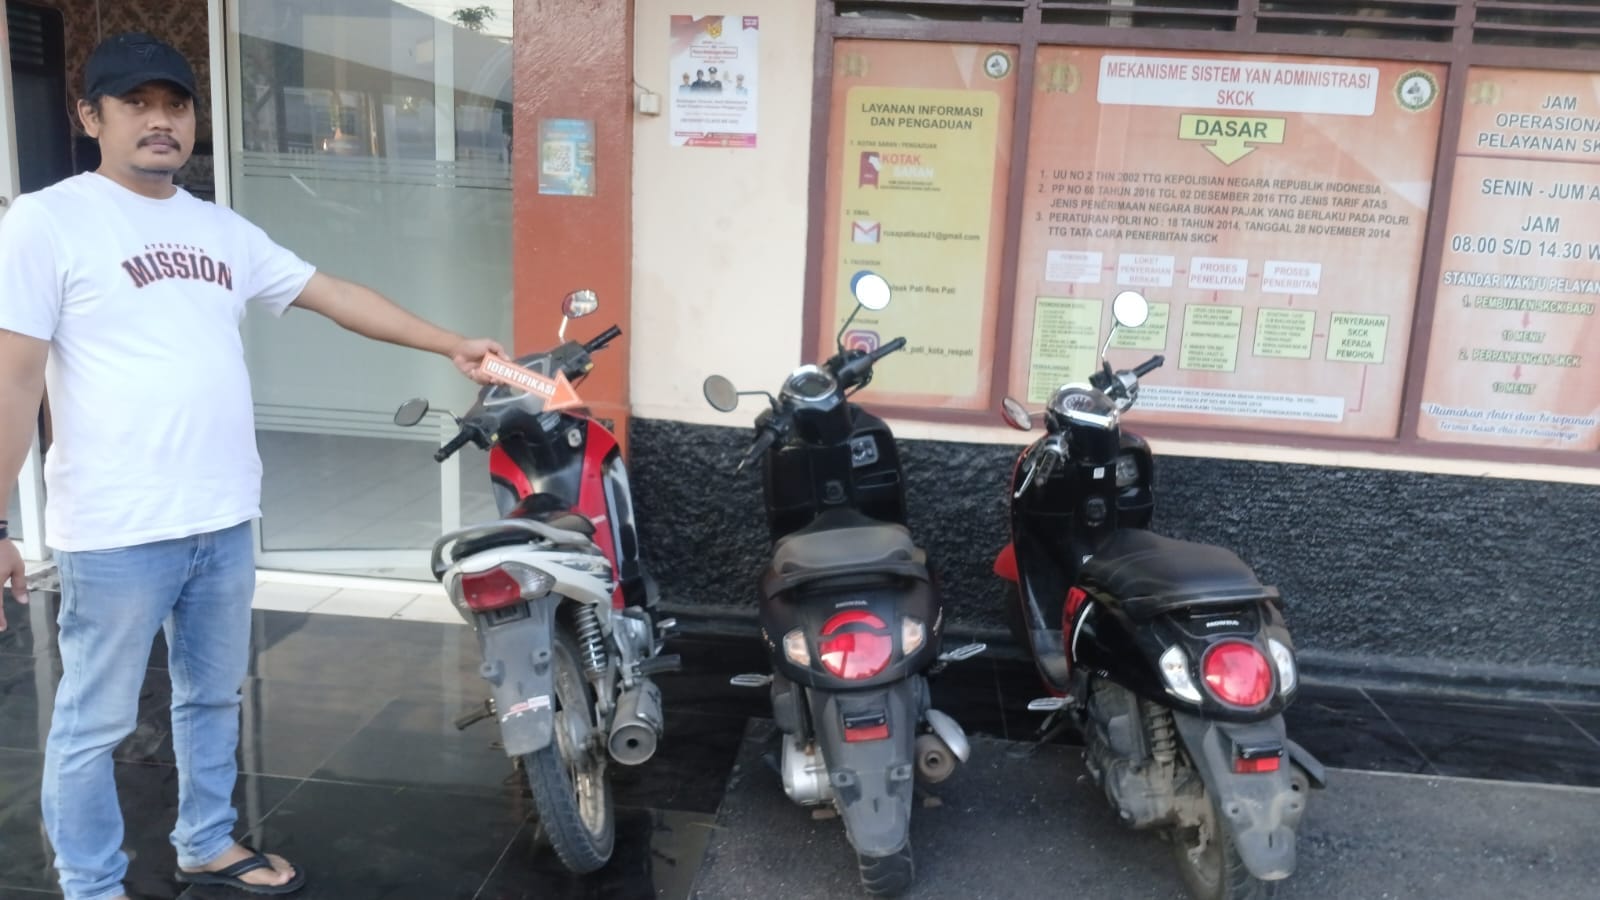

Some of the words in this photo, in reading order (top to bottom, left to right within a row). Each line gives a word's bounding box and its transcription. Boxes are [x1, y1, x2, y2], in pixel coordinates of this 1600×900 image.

[1106, 62, 1188, 82] MEKANISME
[1191, 65, 1240, 84] SISTEM
[1244, 68, 1271, 85] YAN
[1273, 69, 1371, 89] ADMINISTRASI
[1217, 89, 1254, 106] SKCK
[1542, 96, 1577, 110] JAM
[862, 103, 915, 114] LAYANAN
[918, 105, 983, 117] INFORMASI
[870, 116, 895, 127] DAN
[898, 118, 973, 130] PENGADUAN
[1195, 118, 1267, 139] DASAR
[1478, 133, 1577, 151] PELAYANAN
[881, 152, 921, 165] KOTAK
[1053, 170, 1067, 180] UU
[1069, 170, 1083, 180] NO
[1084, 171, 1092, 181] 2
[1096, 171, 1115, 182] THN
[1118, 172, 1139, 182] 2002
[1142, 173, 1161, 183] TTG
[1164, 174, 1225, 186] KEPOLISIAN
[1227, 177, 1270, 189] NEGARA
[1273, 179, 1323, 191] REPUBLIK
[1326, 182, 1381, 194] INDONESIA
[1481, 179, 1533, 196] SENIN
[1052, 184, 1064, 194] PP
[1067, 184, 1082, 194] NO
[1099, 186, 1131, 197] TAHUN
[1159, 188, 1177, 199] TGL
[1193, 190, 1250, 201] DESEMBER
[1278, 194, 1297, 204] TTG
[1299, 195, 1328, 206] JENIS
[1332, 196, 1360, 207] TARIF
[1361, 198, 1388, 209] ATAS
[1050, 198, 1078, 209] JENIS
[1081, 199, 1146, 211] PENERIMAAN
[1148, 202, 1190, 214] NEGARA
[1193, 204, 1229, 216] BUKAN
[1231, 206, 1264, 217] PAJAK
[1267, 208, 1294, 219] YANG
[1297, 210, 1346, 222] BERLAKU
[1348, 212, 1376, 223] PADA
[1049, 212, 1109, 224] PERATURAN
[1111, 215, 1142, 226] POLRI
[1144, 216, 1159, 226] NO
[1181, 219, 1214, 230] TAHUN
[1244, 221, 1291, 234] TANGGAL
[1295, 224, 1305, 234] 28
[1309, 224, 1365, 237] NOVEMBER
[1367, 228, 1391, 239] 2014
[1521, 216, 1559, 232] JAM
[1048, 226, 1067, 237] TTG
[1070, 226, 1093, 238] TATA
[1095, 228, 1123, 240] CARA
[1125, 229, 1187, 242] PENERBITAN
[1190, 232, 1218, 243] SKCK
[1452, 236, 1496, 254] 08.00
[1503, 239, 1531, 256] S/D
[1539, 242, 1582, 260] 14.30
[121, 250, 233, 291] MISSION
[1200, 263, 1238, 273] PROSES
[1274, 267, 1310, 277] PROSES
[1191, 275, 1244, 285] PENELITIAN
[1263, 278, 1318, 289] PENERBITAN
[1444, 271, 1500, 287] STANDAR
[1503, 275, 1546, 290] WAKTU
[1474, 295, 1535, 311] PEMBUATAN
[1536, 299, 1565, 313] SKCK
[1565, 302, 1595, 316] BARU
[1334, 316, 1385, 327] PENYERAHAN
[1347, 328, 1369, 337] SKCK
[1515, 331, 1546, 343] MENIT
[1341, 339, 1372, 348] KEPADA
[1336, 350, 1375, 359] PEMOHON
[1472, 349, 1551, 365] PERPANJANGAN
[1552, 355, 1583, 368] SKCK
[486, 361, 557, 396] IDENTIFIKASI
[1504, 383, 1536, 395] MENIT
[1428, 404, 1483, 418] Utamakan
[1486, 408, 1513, 420] Antri
[1515, 410, 1536, 421] dan
[835, 600, 869, 608] HONDA
[1206, 620, 1240, 628] HONDA
